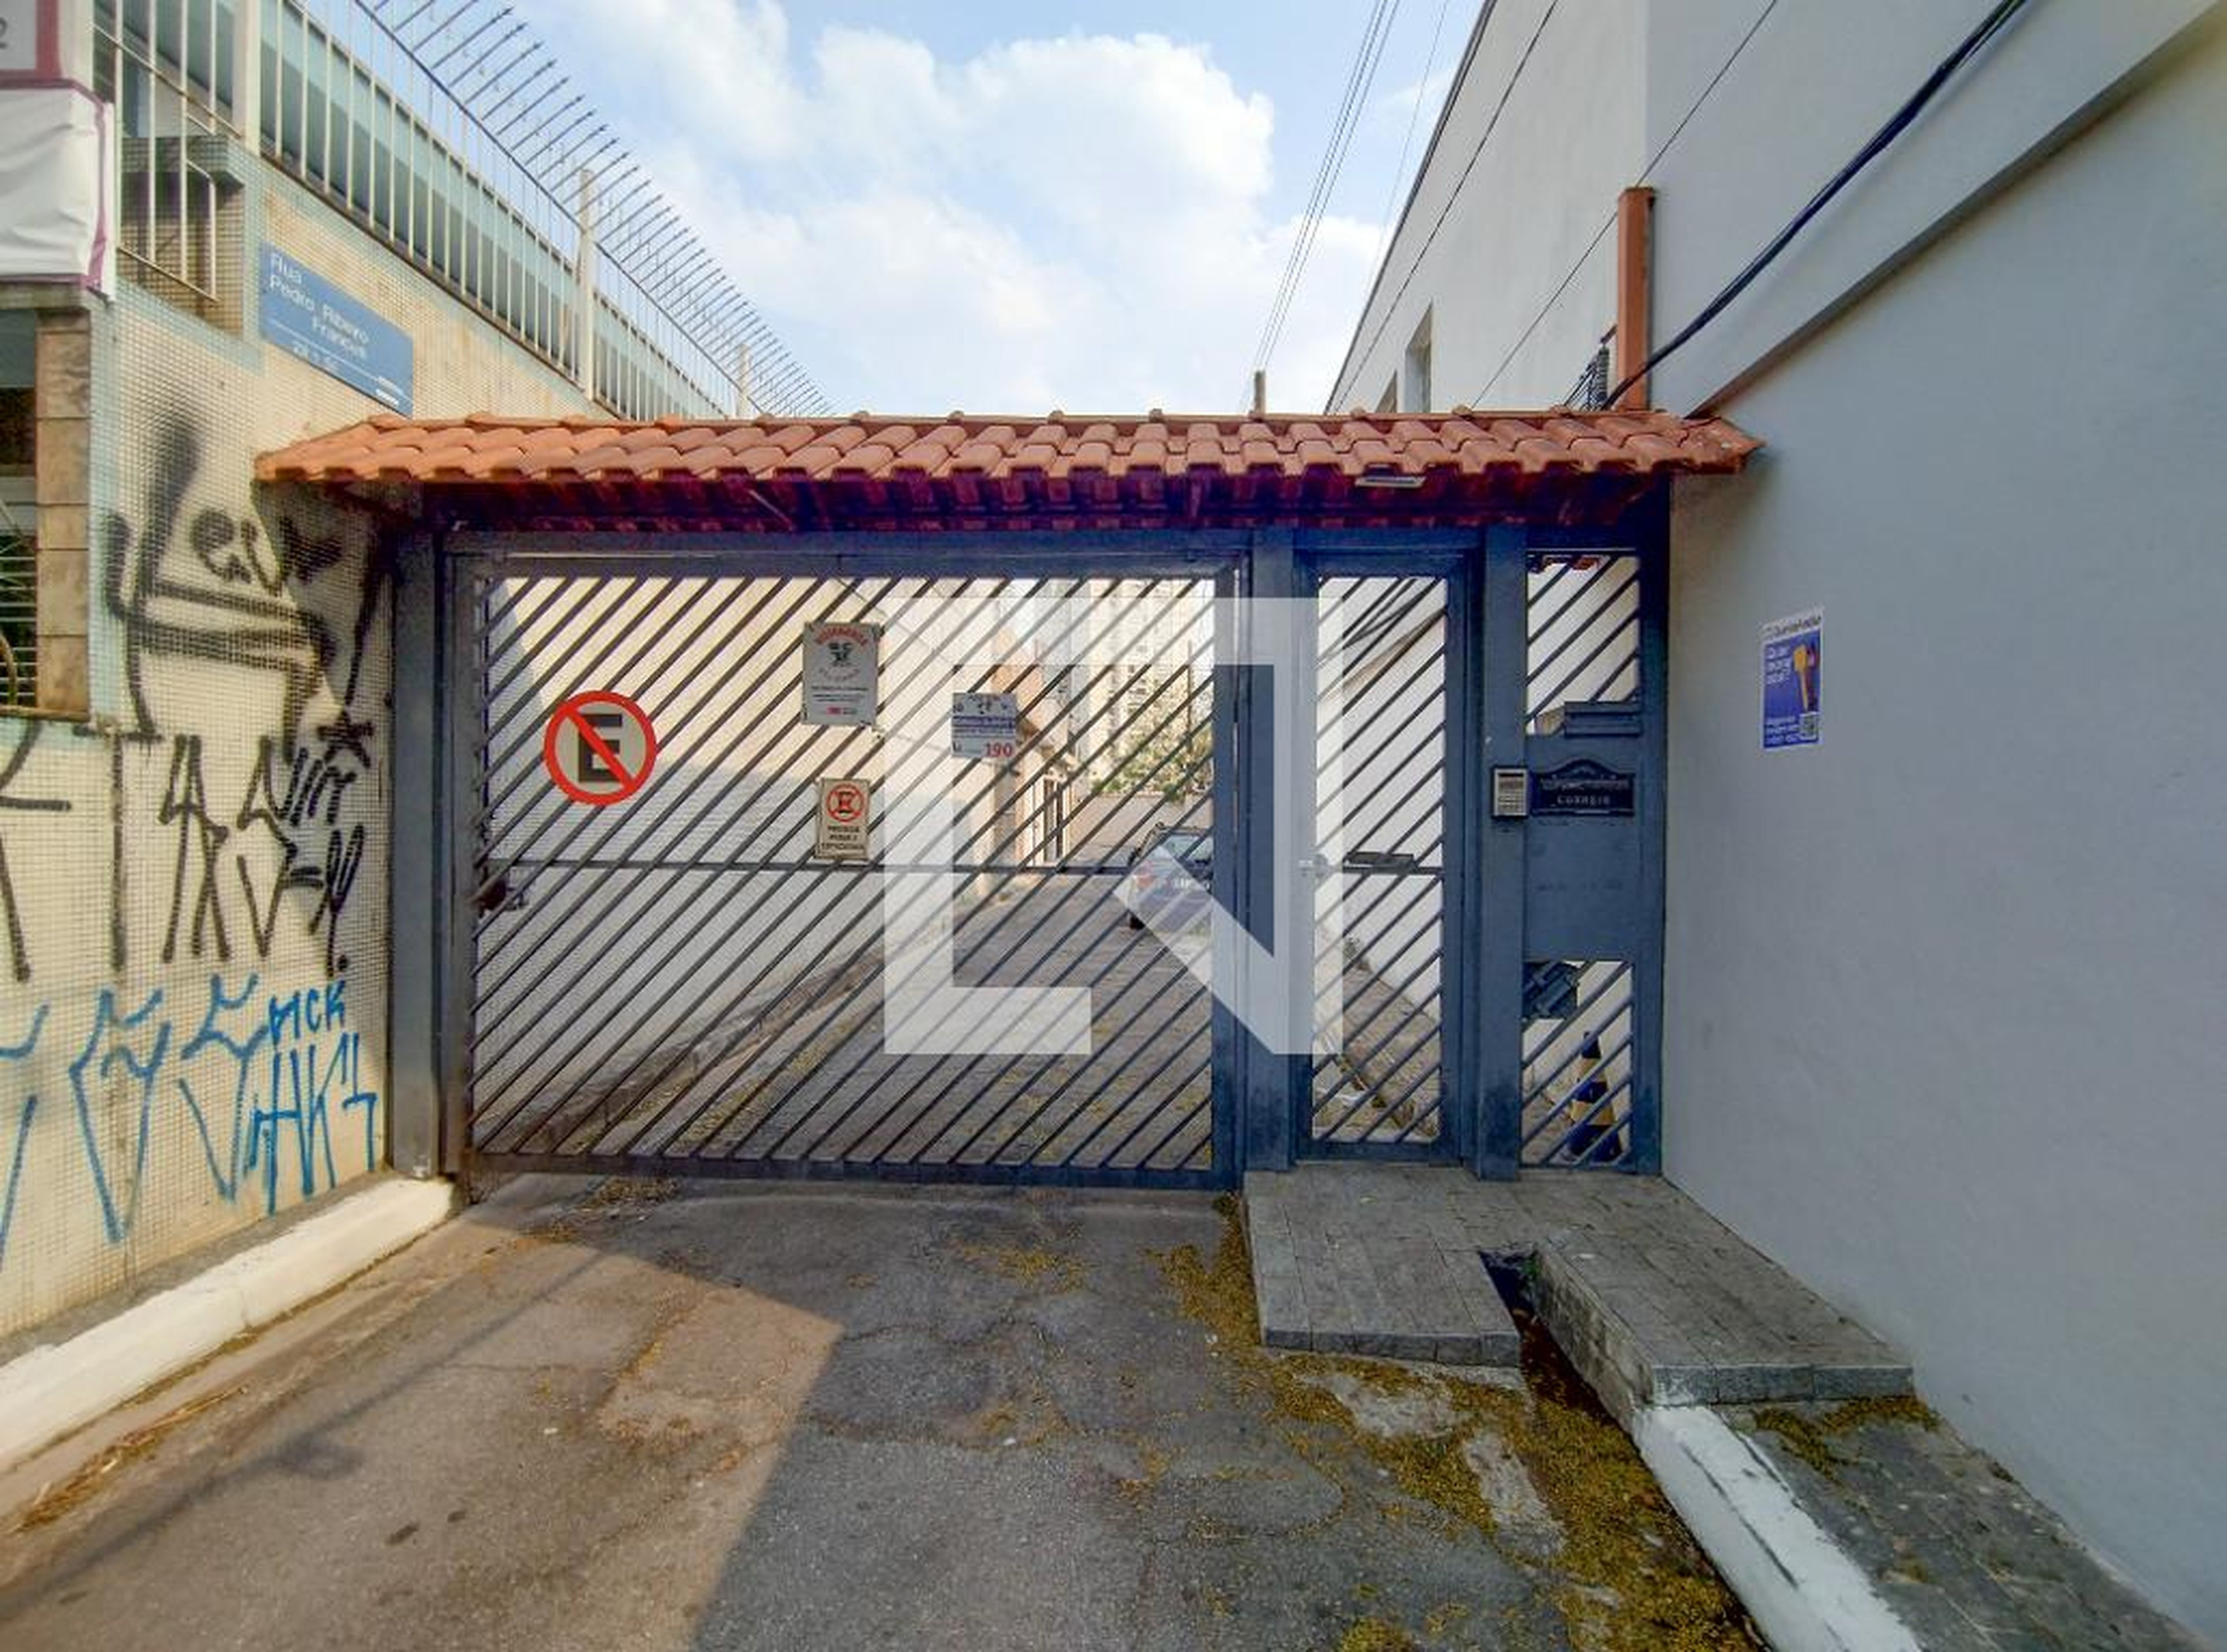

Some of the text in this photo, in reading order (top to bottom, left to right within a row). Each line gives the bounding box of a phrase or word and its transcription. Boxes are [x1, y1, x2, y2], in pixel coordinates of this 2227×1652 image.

[270, 253, 302, 285] Rua
[270, 275, 315, 313] Pedro
[985, 742, 1013, 757] 190
